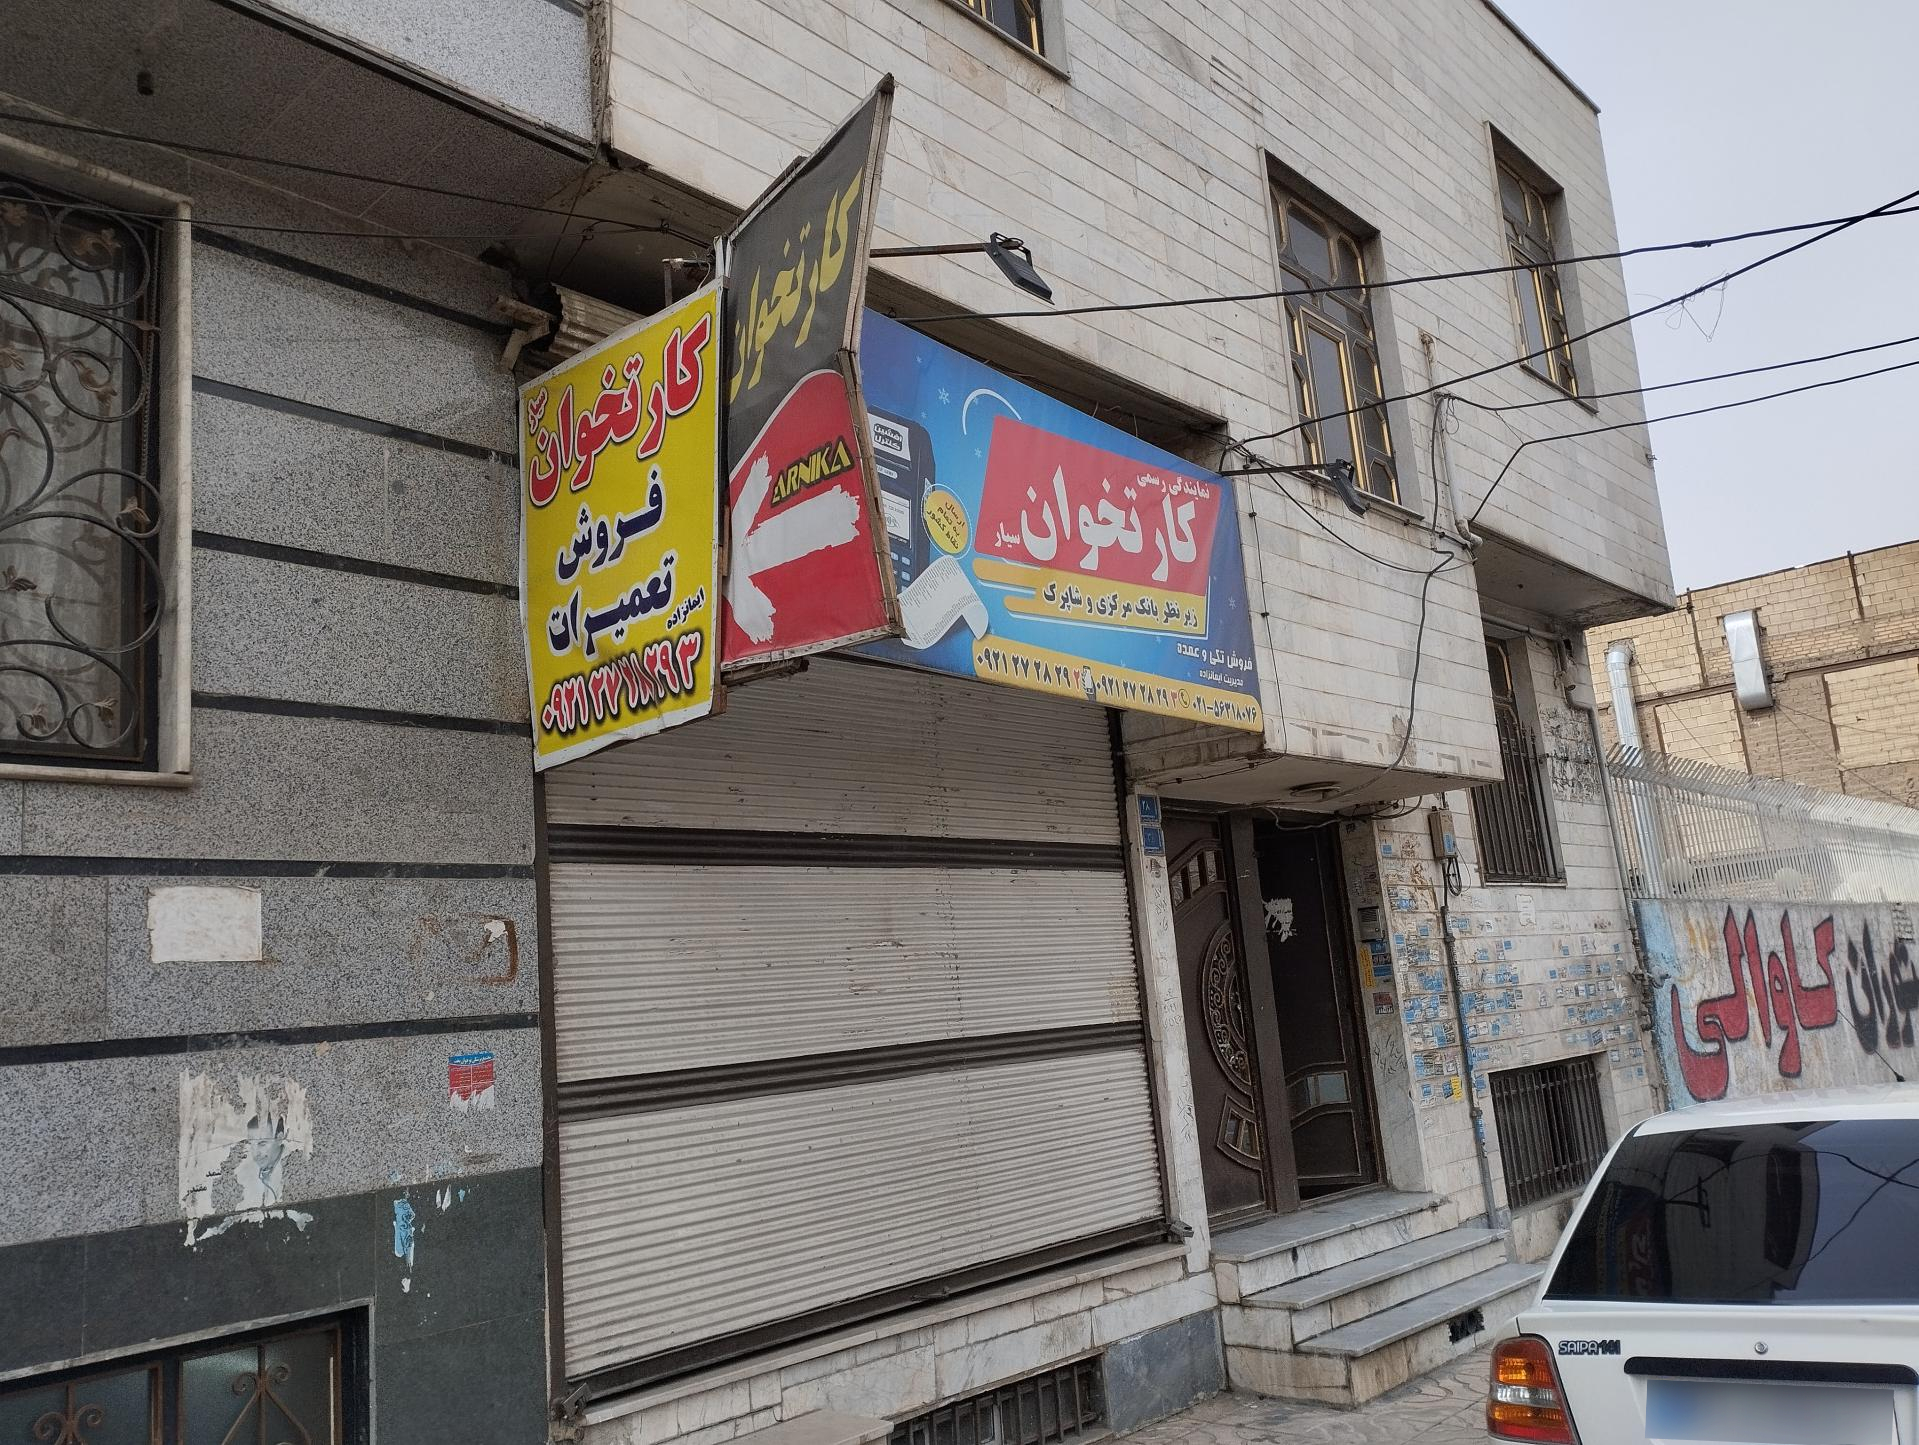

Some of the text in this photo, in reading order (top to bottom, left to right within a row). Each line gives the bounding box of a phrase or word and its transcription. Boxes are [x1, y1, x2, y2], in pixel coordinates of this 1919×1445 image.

[528, 312, 712, 507] کارتخوان سیار
[873, 424, 903, 443] افشین
[874, 435, 902, 451] کنترل
[771, 438, 853, 503] ARNIKA
[1136, 473, 1210, 499] نمایندگی رسمی
[556, 464, 664, 581] فروش
[926, 510, 959, 550] نقاط کشور
[937, 507, 960, 538] به تمام
[945, 502, 966, 529] ارسال
[994, 464, 1197, 582] کارتخوان سیار
[548, 554, 676, 658] تعمیرات
[666, 586, 706, 630] ایمانزاده
[1043, 584, 1198, 627] زیر نظر بانک مرکزی و شاپرک
[1177, 642, 1253, 671] فروش تکی و عمده
[1223, 674, 1244, 687] مدیریت
[1558, 1340, 1599, 1356] SAIPA
